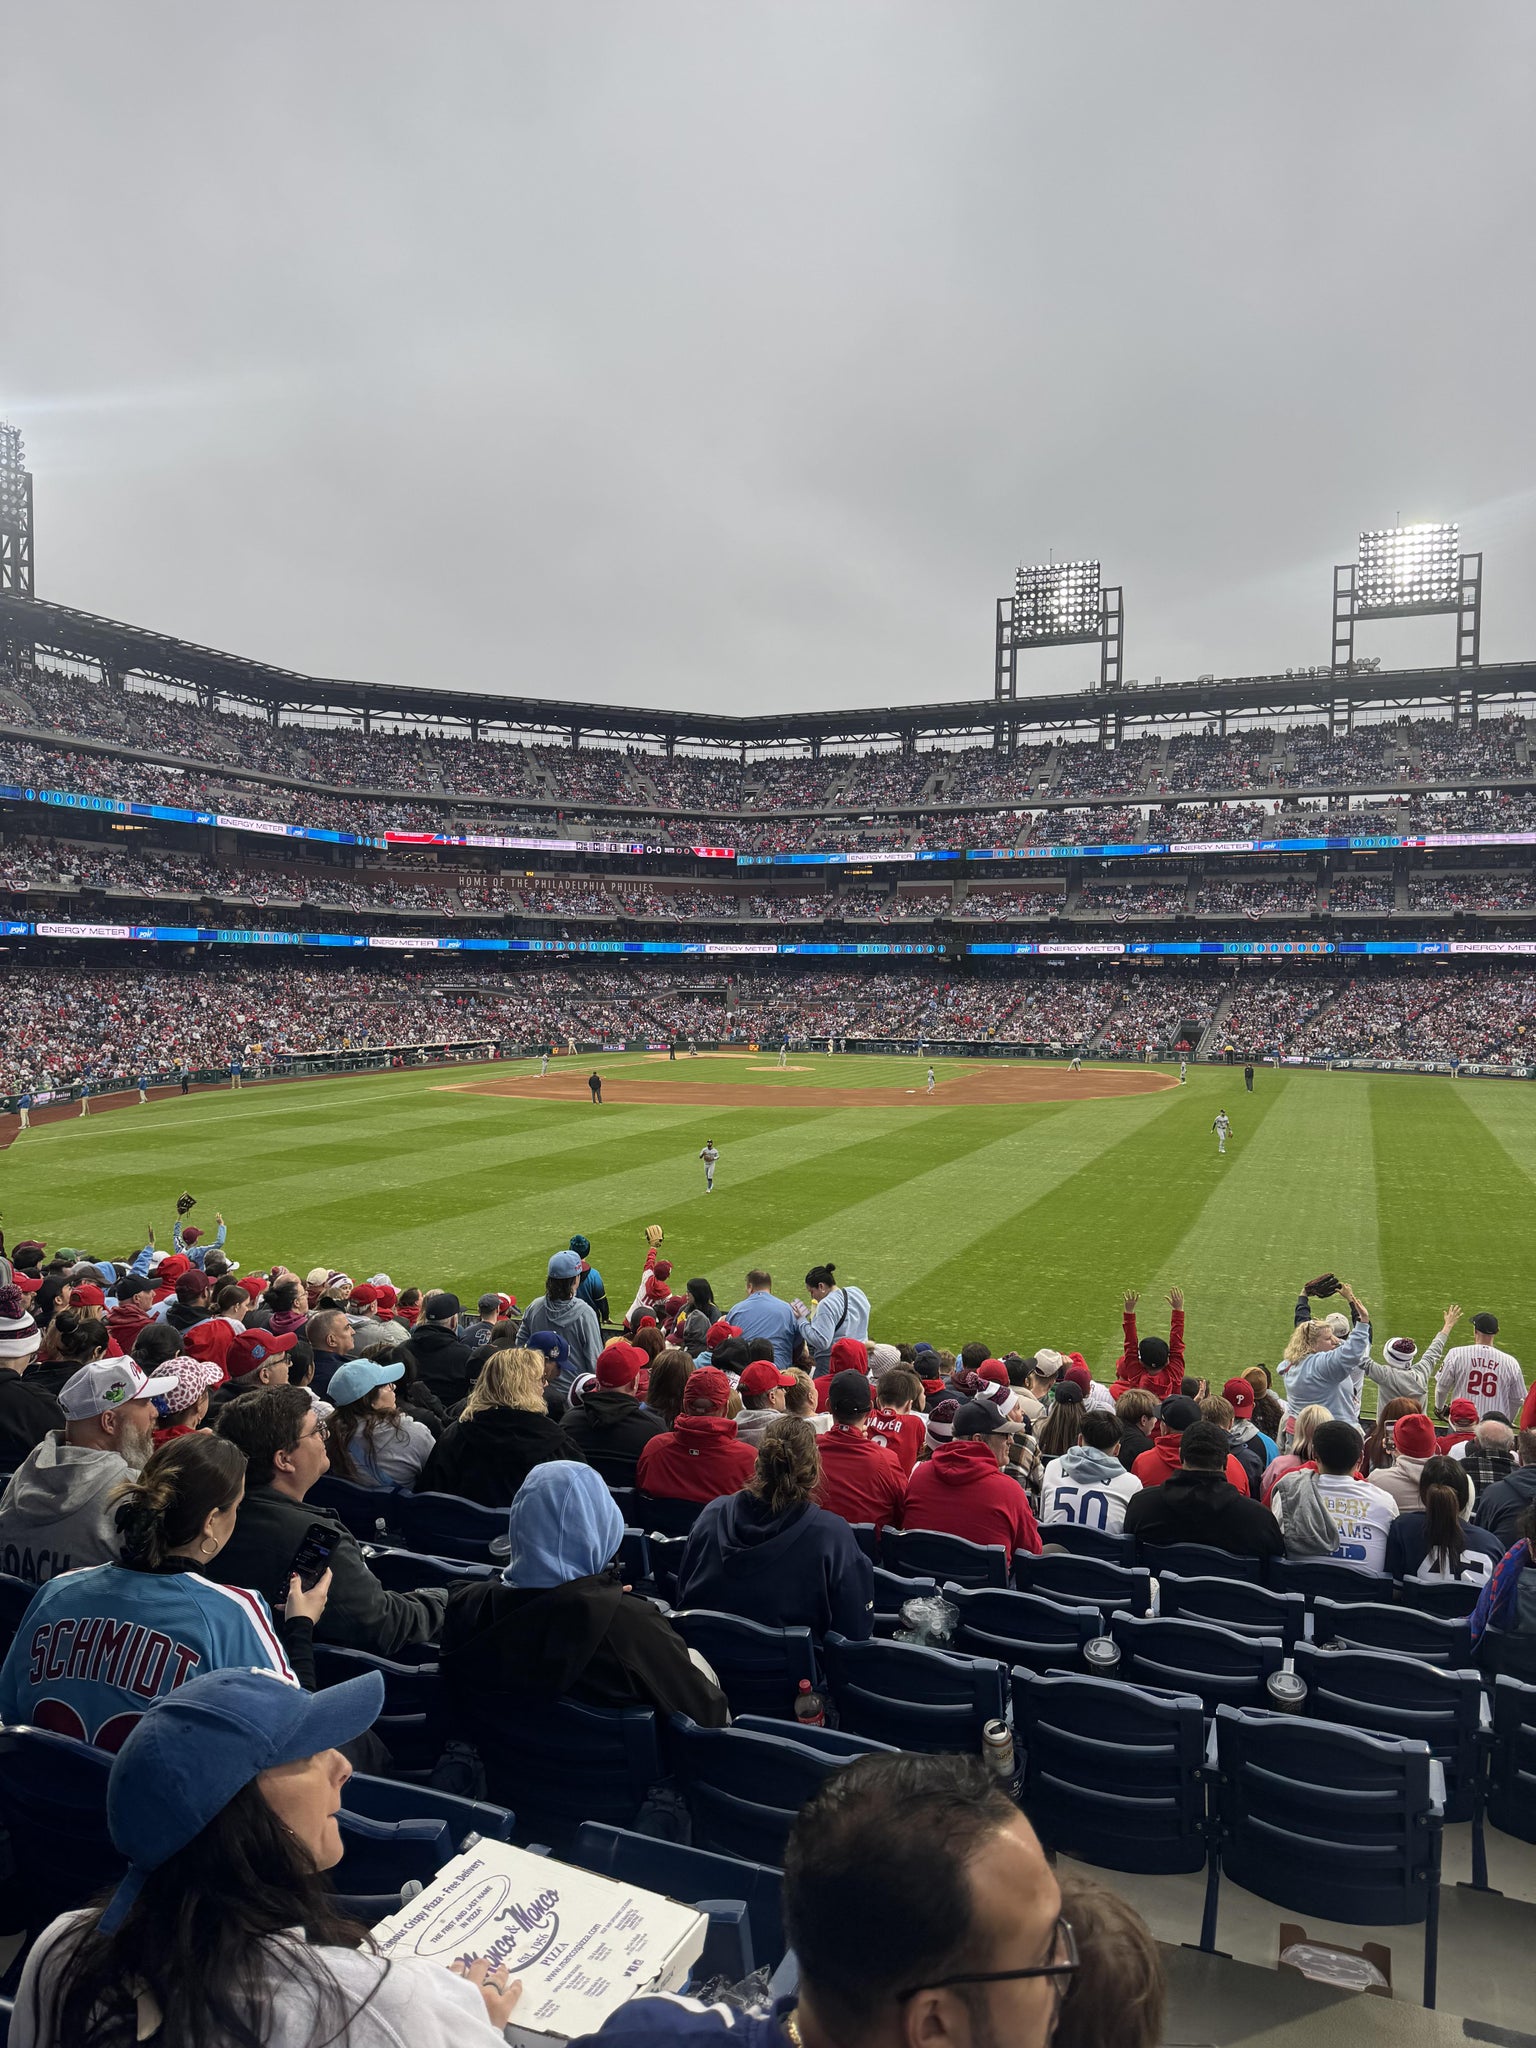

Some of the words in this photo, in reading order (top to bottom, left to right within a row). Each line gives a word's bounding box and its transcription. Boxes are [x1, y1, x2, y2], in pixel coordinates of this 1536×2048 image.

[221, 817, 255, 828] ENERGY
[256, 823, 284, 832] METER
[646, 846, 662, 854] 0-0
[459, 876, 488, 887] HOME
[493, 877, 505, 887] OF
[511, 878, 529, 888] THE
[534, 879, 606, 891] PHILADELPHIA
[611, 882, 655, 892] PHILLIES
[41, 925, 87, 935] ENERGY
[89, 927, 126, 936] METER
[371, 938, 399, 946] ENERGY
[1340, 1060, 1350, 1068] 10
[1381, 1062, 1391, 1070] 10
[1425, 1064, 1435, 1072] 10
[1469, 1065, 1480, 1074] 10
[1516, 1068, 1527, 1077] 10
[1471, 1358, 1499, 1371] UTLEY
[1467, 1370, 1498, 1398] 26
[1236, 1394, 1245, 1405] P
[1053, 1487, 1109, 1531] 50
[1338, 1526, 1372, 1540] AMS
[0, 1543, 71, 1584] OACH
[1417, 1545, 1493, 1588] 42
[29, 1617, 201, 1700] SCHMIDT
[403, 1909, 430, 1930] Crispy
[422, 1895, 444, 1913] Pizza
[442, 1880, 460, 1894] Free
[455, 1859, 486, 1881] Delivery
[430, 1932, 444, 1944] THE
[441, 1920, 456, 1935] FIRST
[454, 1909, 467, 1923] AND
[465, 1898, 479, 1912] LAST
[477, 1885, 494, 1901] NAME
[494, 1889, 560, 1934] Manco
[459, 1920, 467, 1929] IN
[504, 1924, 521, 1935] &
[530, 1933, 550, 1951] 1956
[540, 1942, 570, 1967] PIZZA
[544, 1923, 602, 1982] www.mancospizza.com
